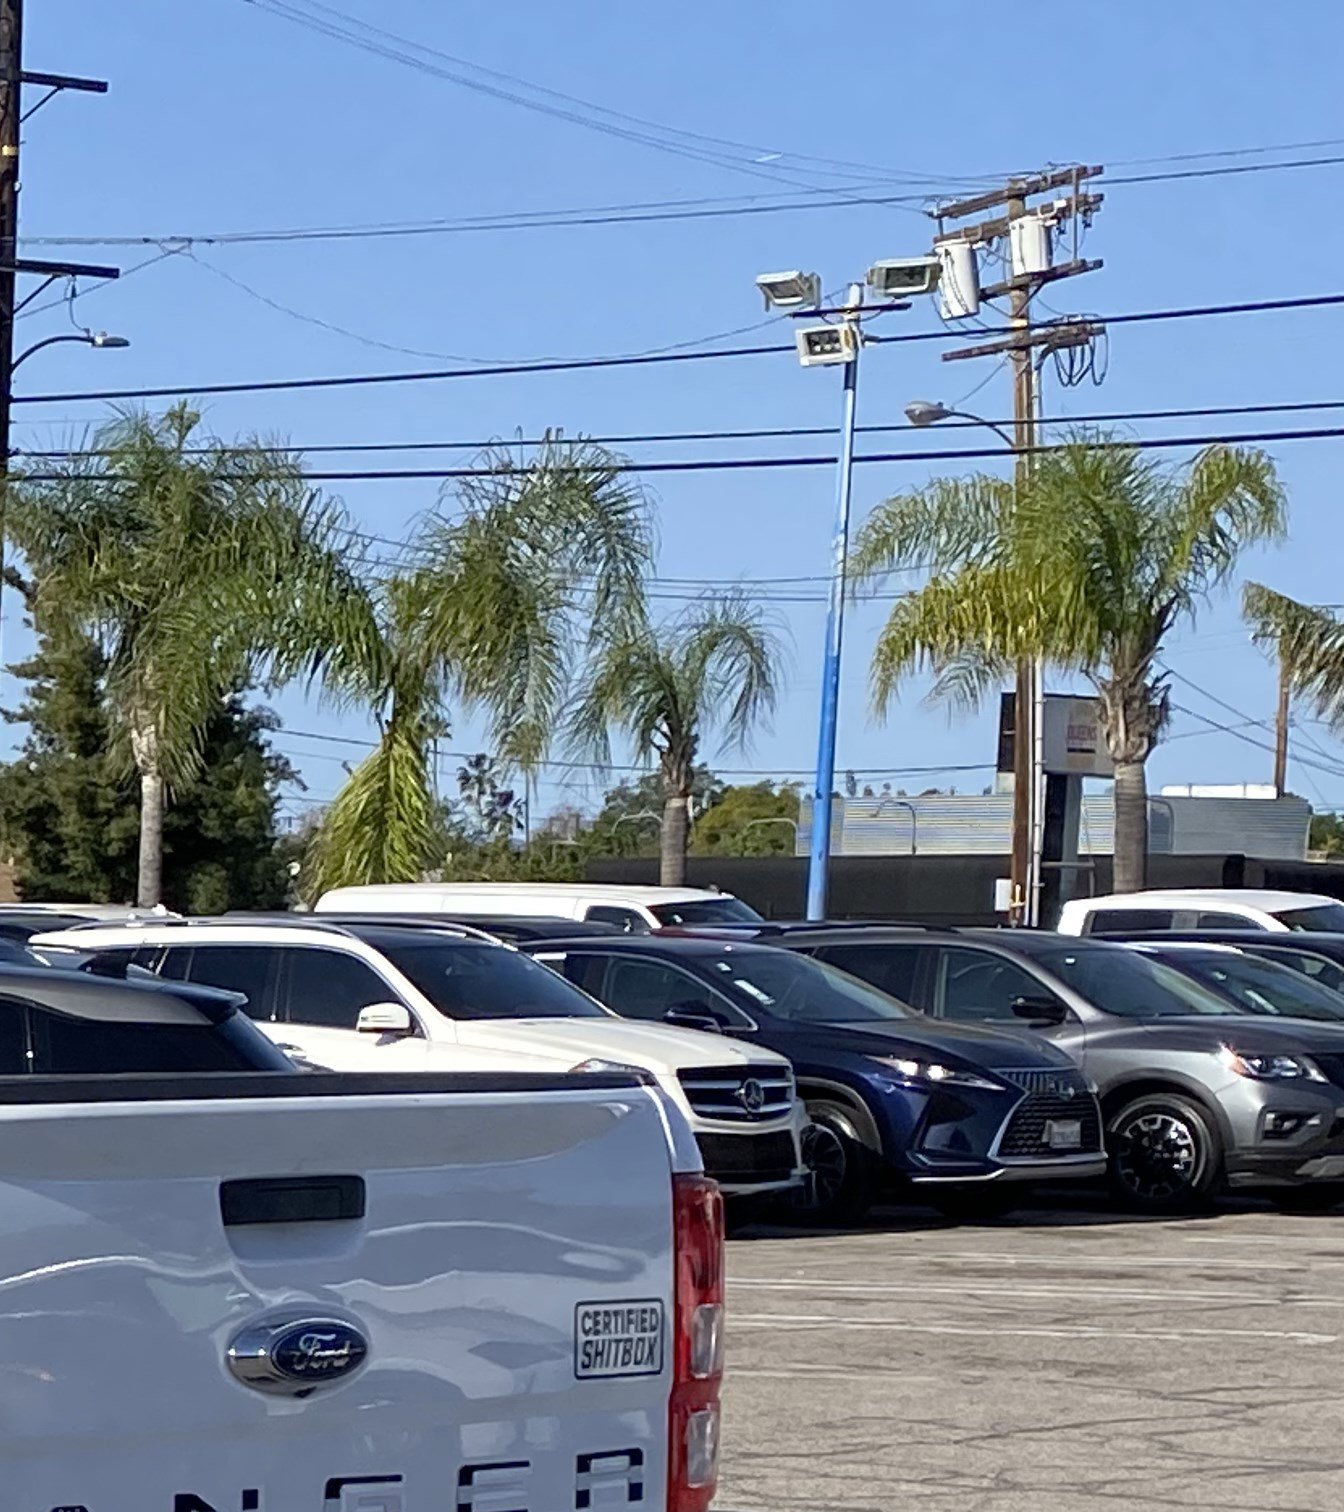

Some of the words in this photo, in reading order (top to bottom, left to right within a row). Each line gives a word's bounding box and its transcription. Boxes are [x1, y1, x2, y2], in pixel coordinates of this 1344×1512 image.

[581, 1307, 660, 1337] CERTIFIED
[291, 1333, 352, 1371] Ford
[581, 1337, 658, 1370] SHITBOX
